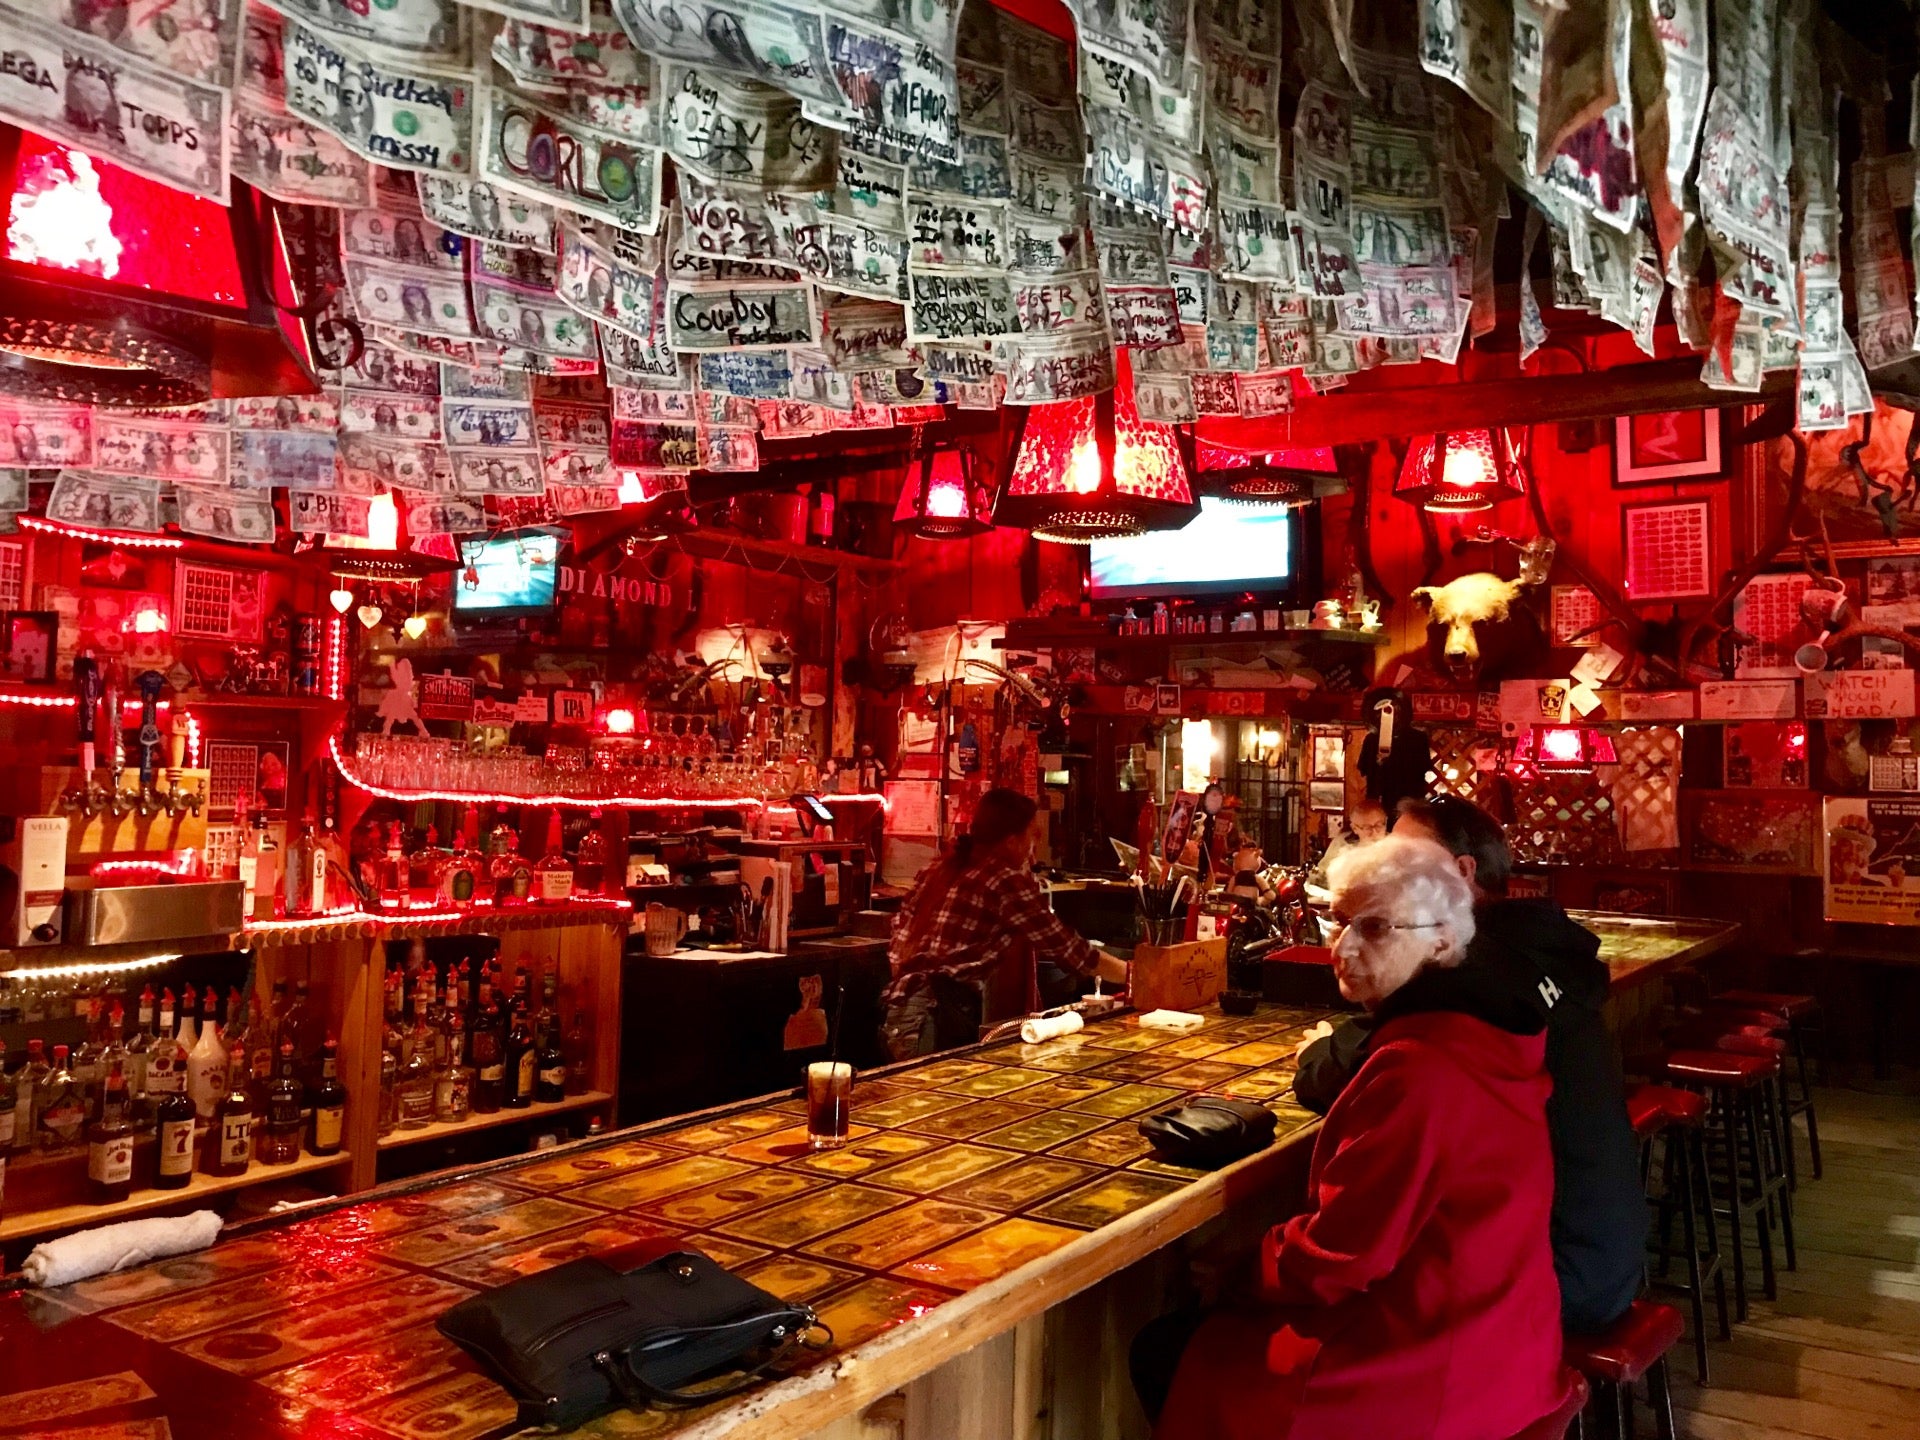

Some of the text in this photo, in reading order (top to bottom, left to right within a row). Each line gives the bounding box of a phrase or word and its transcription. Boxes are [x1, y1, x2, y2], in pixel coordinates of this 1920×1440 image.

[121, 101, 199, 150] TOPPS
[912, 274, 991, 301] CHEYANNE
[973, 319, 1009, 338] NEW
[663, 449, 699, 466] MIKE
[559, 565, 672, 608] DIAMOND
[1818, 675, 1887, 691] WATCH
[563, 698, 586, 718] IPA
[31, 823, 62, 831] VELLA
[173, 1128, 191, 1154] 7
